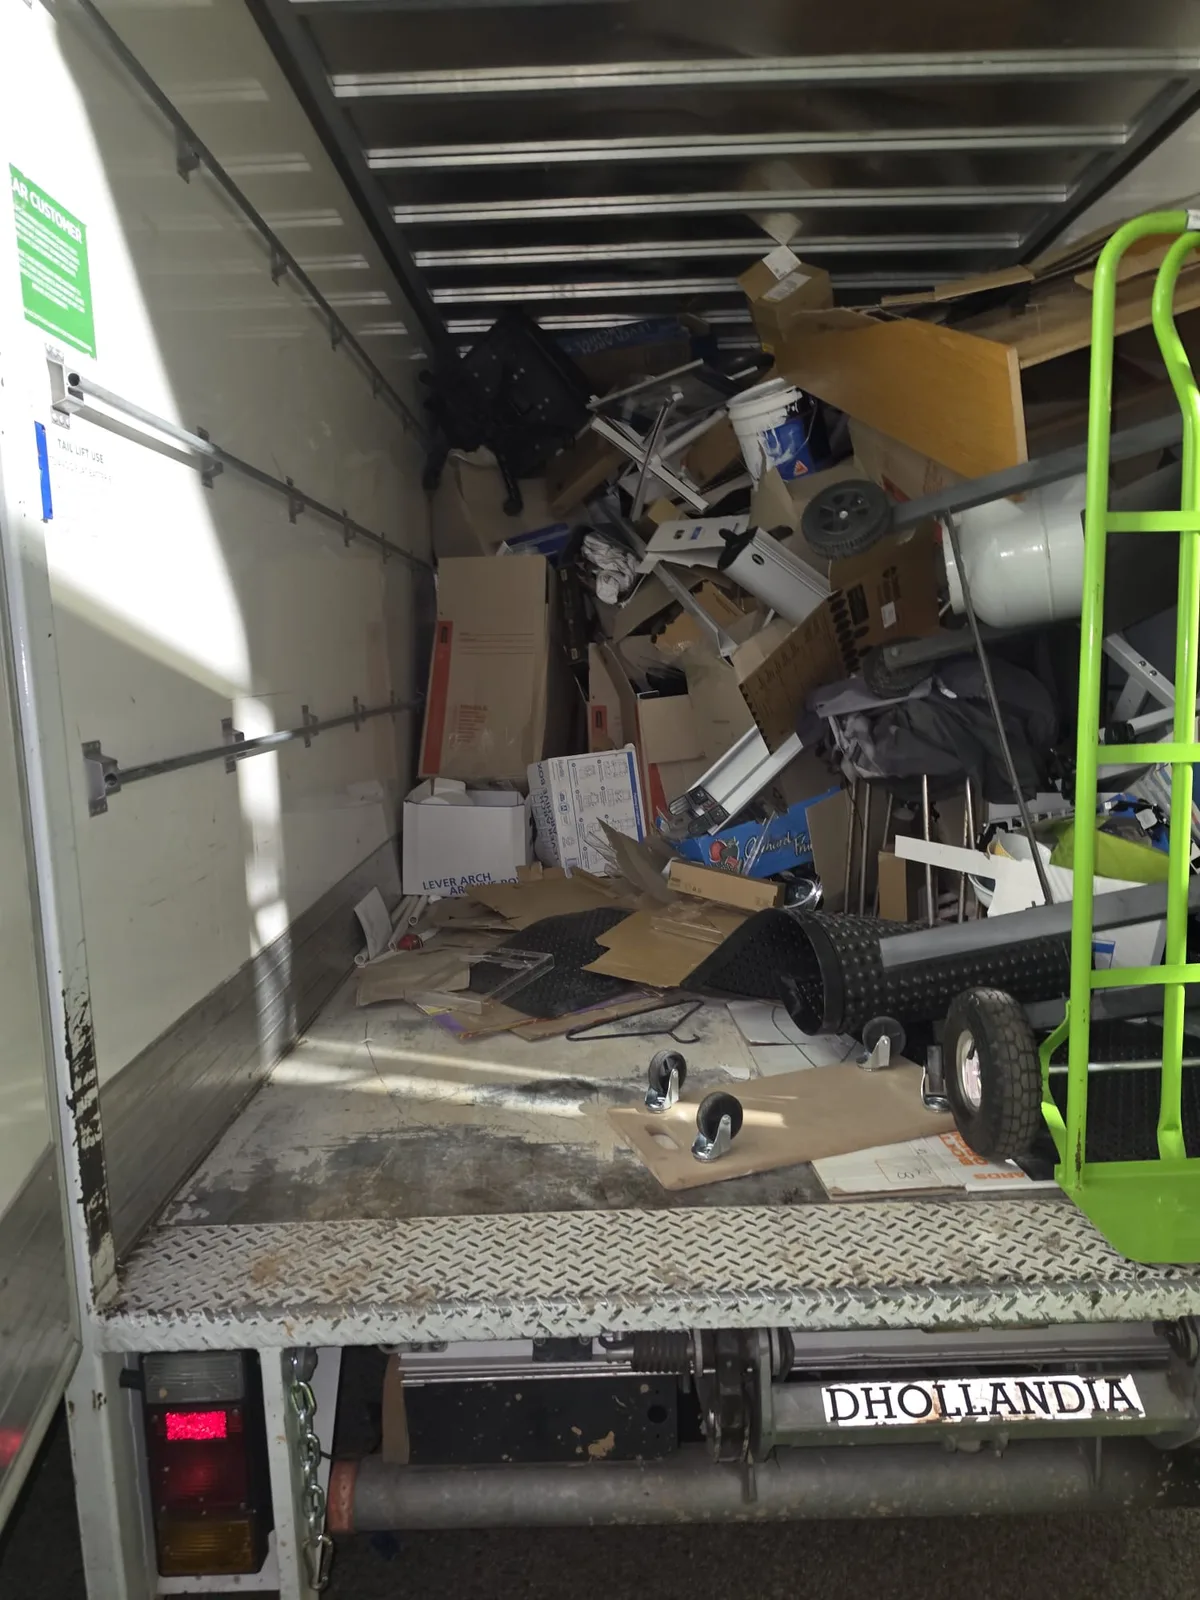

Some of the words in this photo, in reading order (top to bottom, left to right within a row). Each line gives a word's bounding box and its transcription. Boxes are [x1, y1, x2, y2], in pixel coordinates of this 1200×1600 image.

[11, 177, 29, 202] AR
[57, 438, 73, 453] TAIL
[75, 445, 89, 458] LIFT
[91, 450, 104, 464] USE
[422, 877, 457, 890] LEVER
[460, 872, 491, 885] ARCH
[825, 1377, 1137, 1422] DHOLLANDIA
